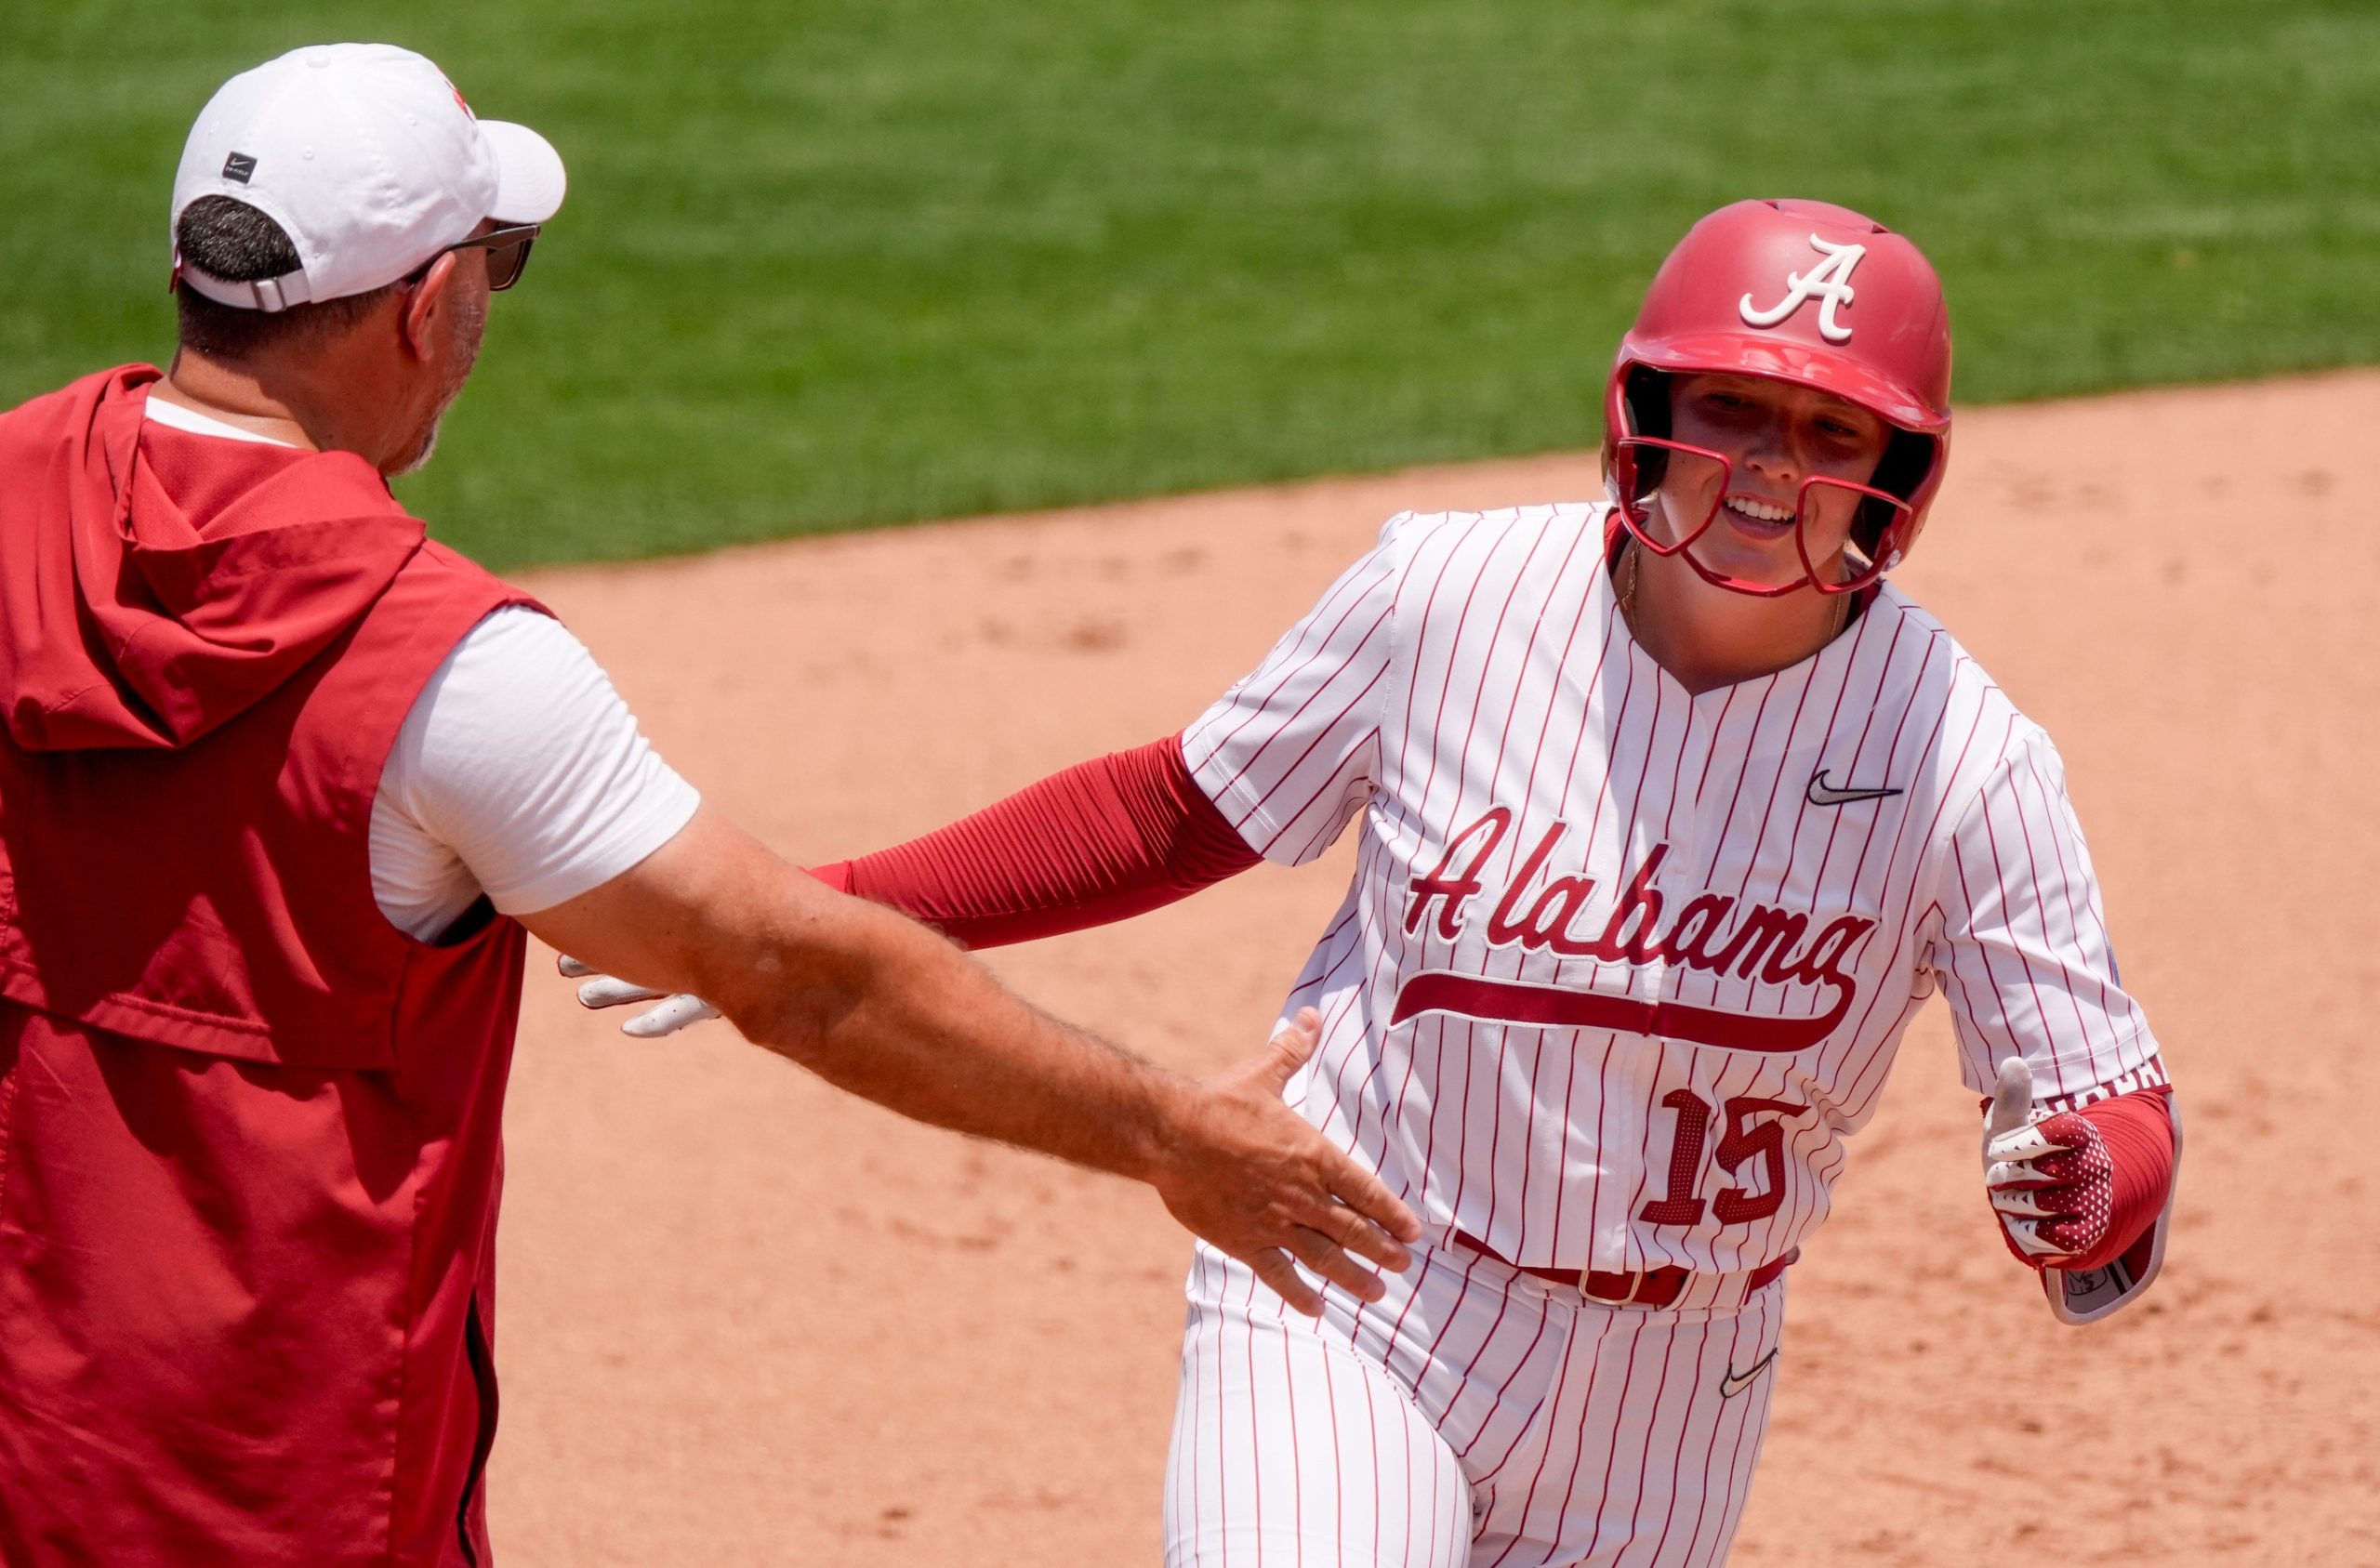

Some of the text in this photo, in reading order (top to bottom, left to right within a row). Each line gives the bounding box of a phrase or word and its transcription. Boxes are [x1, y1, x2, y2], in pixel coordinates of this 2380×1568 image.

[1739, 232, 1867, 341] A
[1404, 802, 1881, 990] Alabama
[1639, 1088, 1811, 1227] 15
